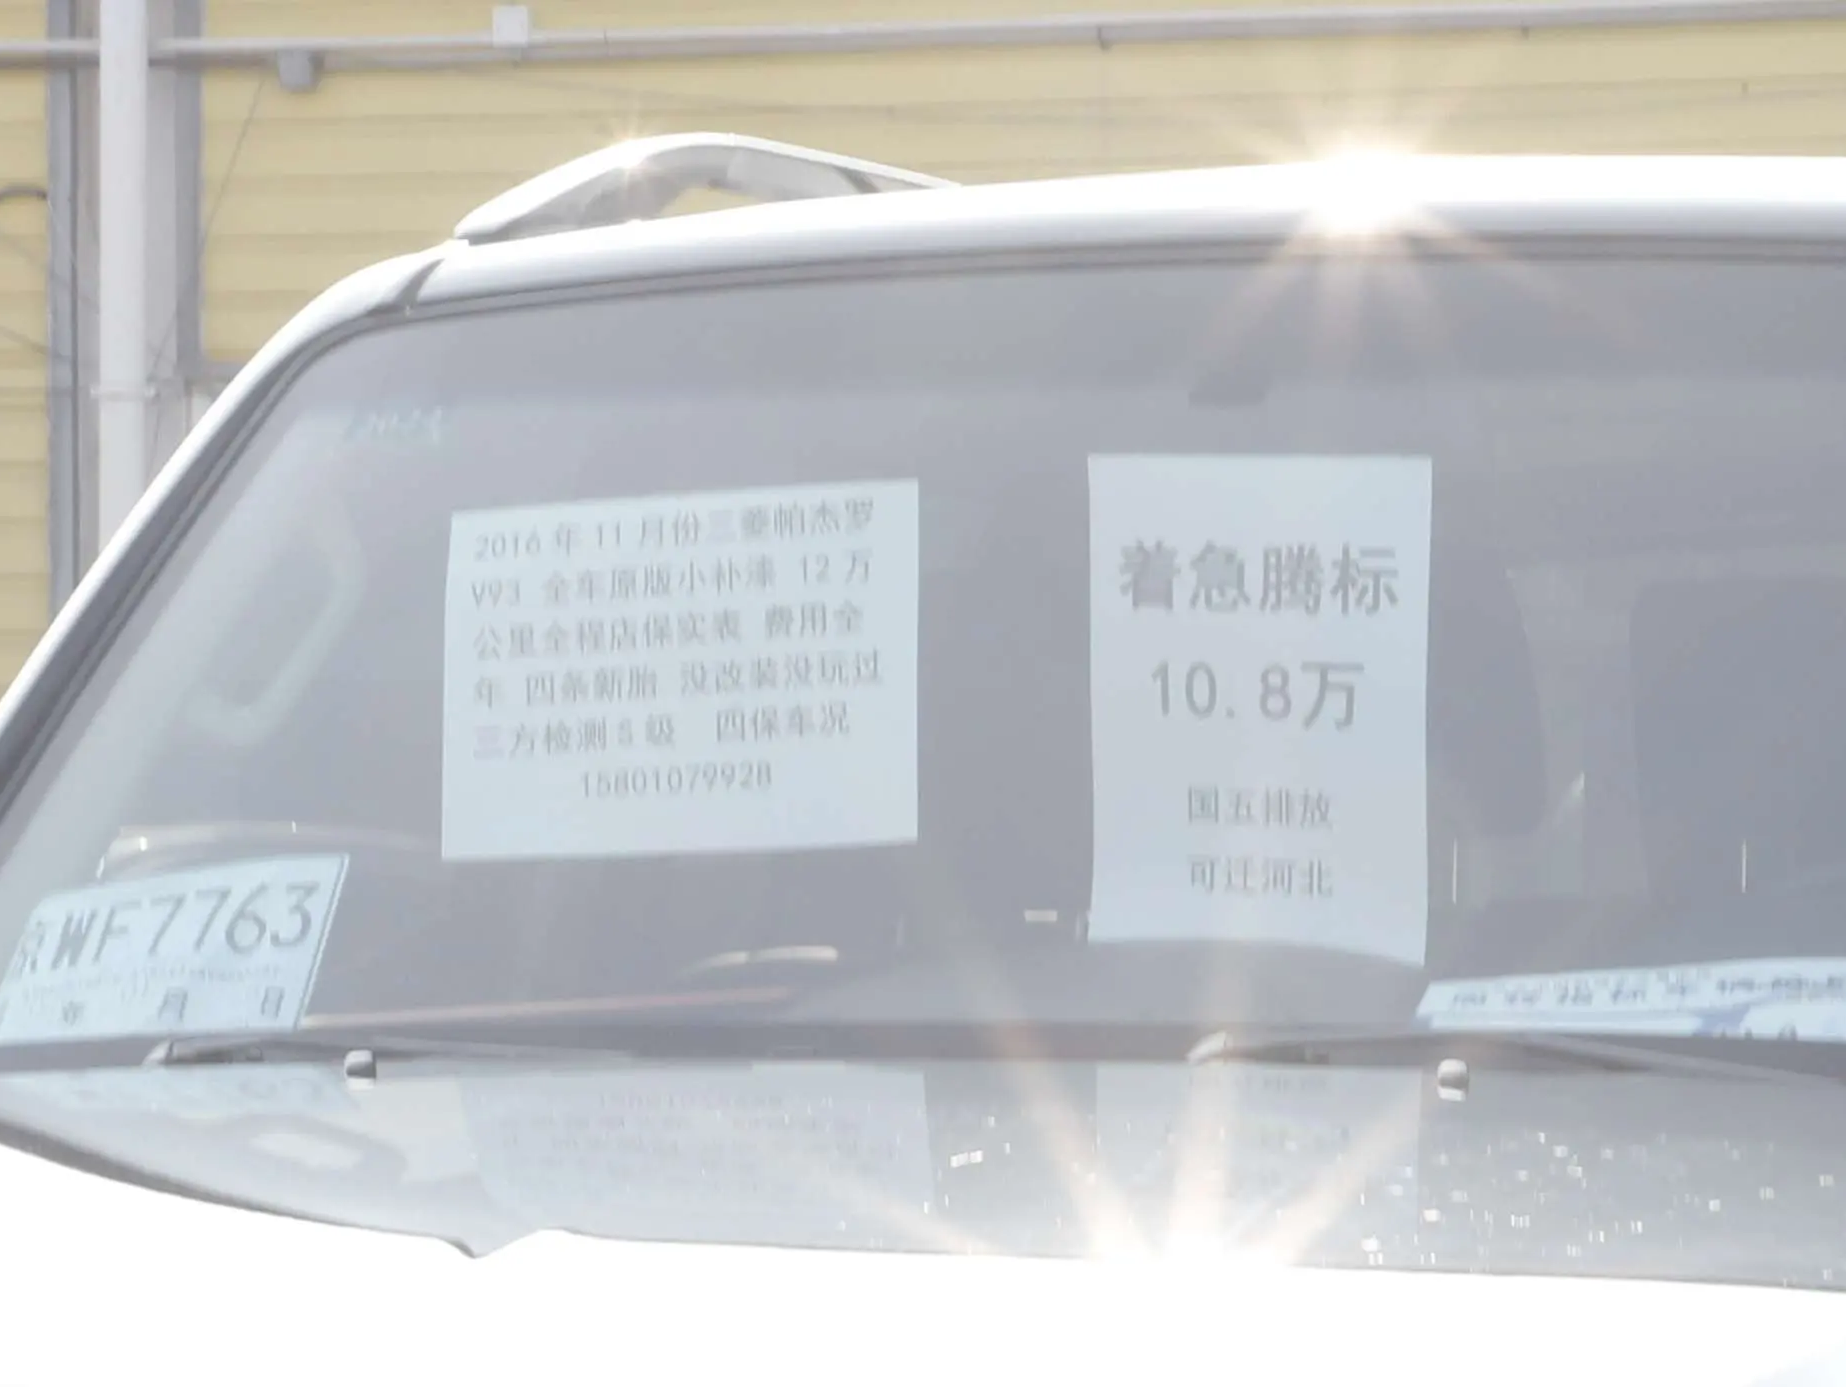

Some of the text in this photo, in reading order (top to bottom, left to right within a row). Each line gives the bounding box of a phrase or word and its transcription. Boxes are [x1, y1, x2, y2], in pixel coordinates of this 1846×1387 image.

[1118, 537, 1400, 618] 着急腾标
[1150, 656, 1365, 733] 10.8万
